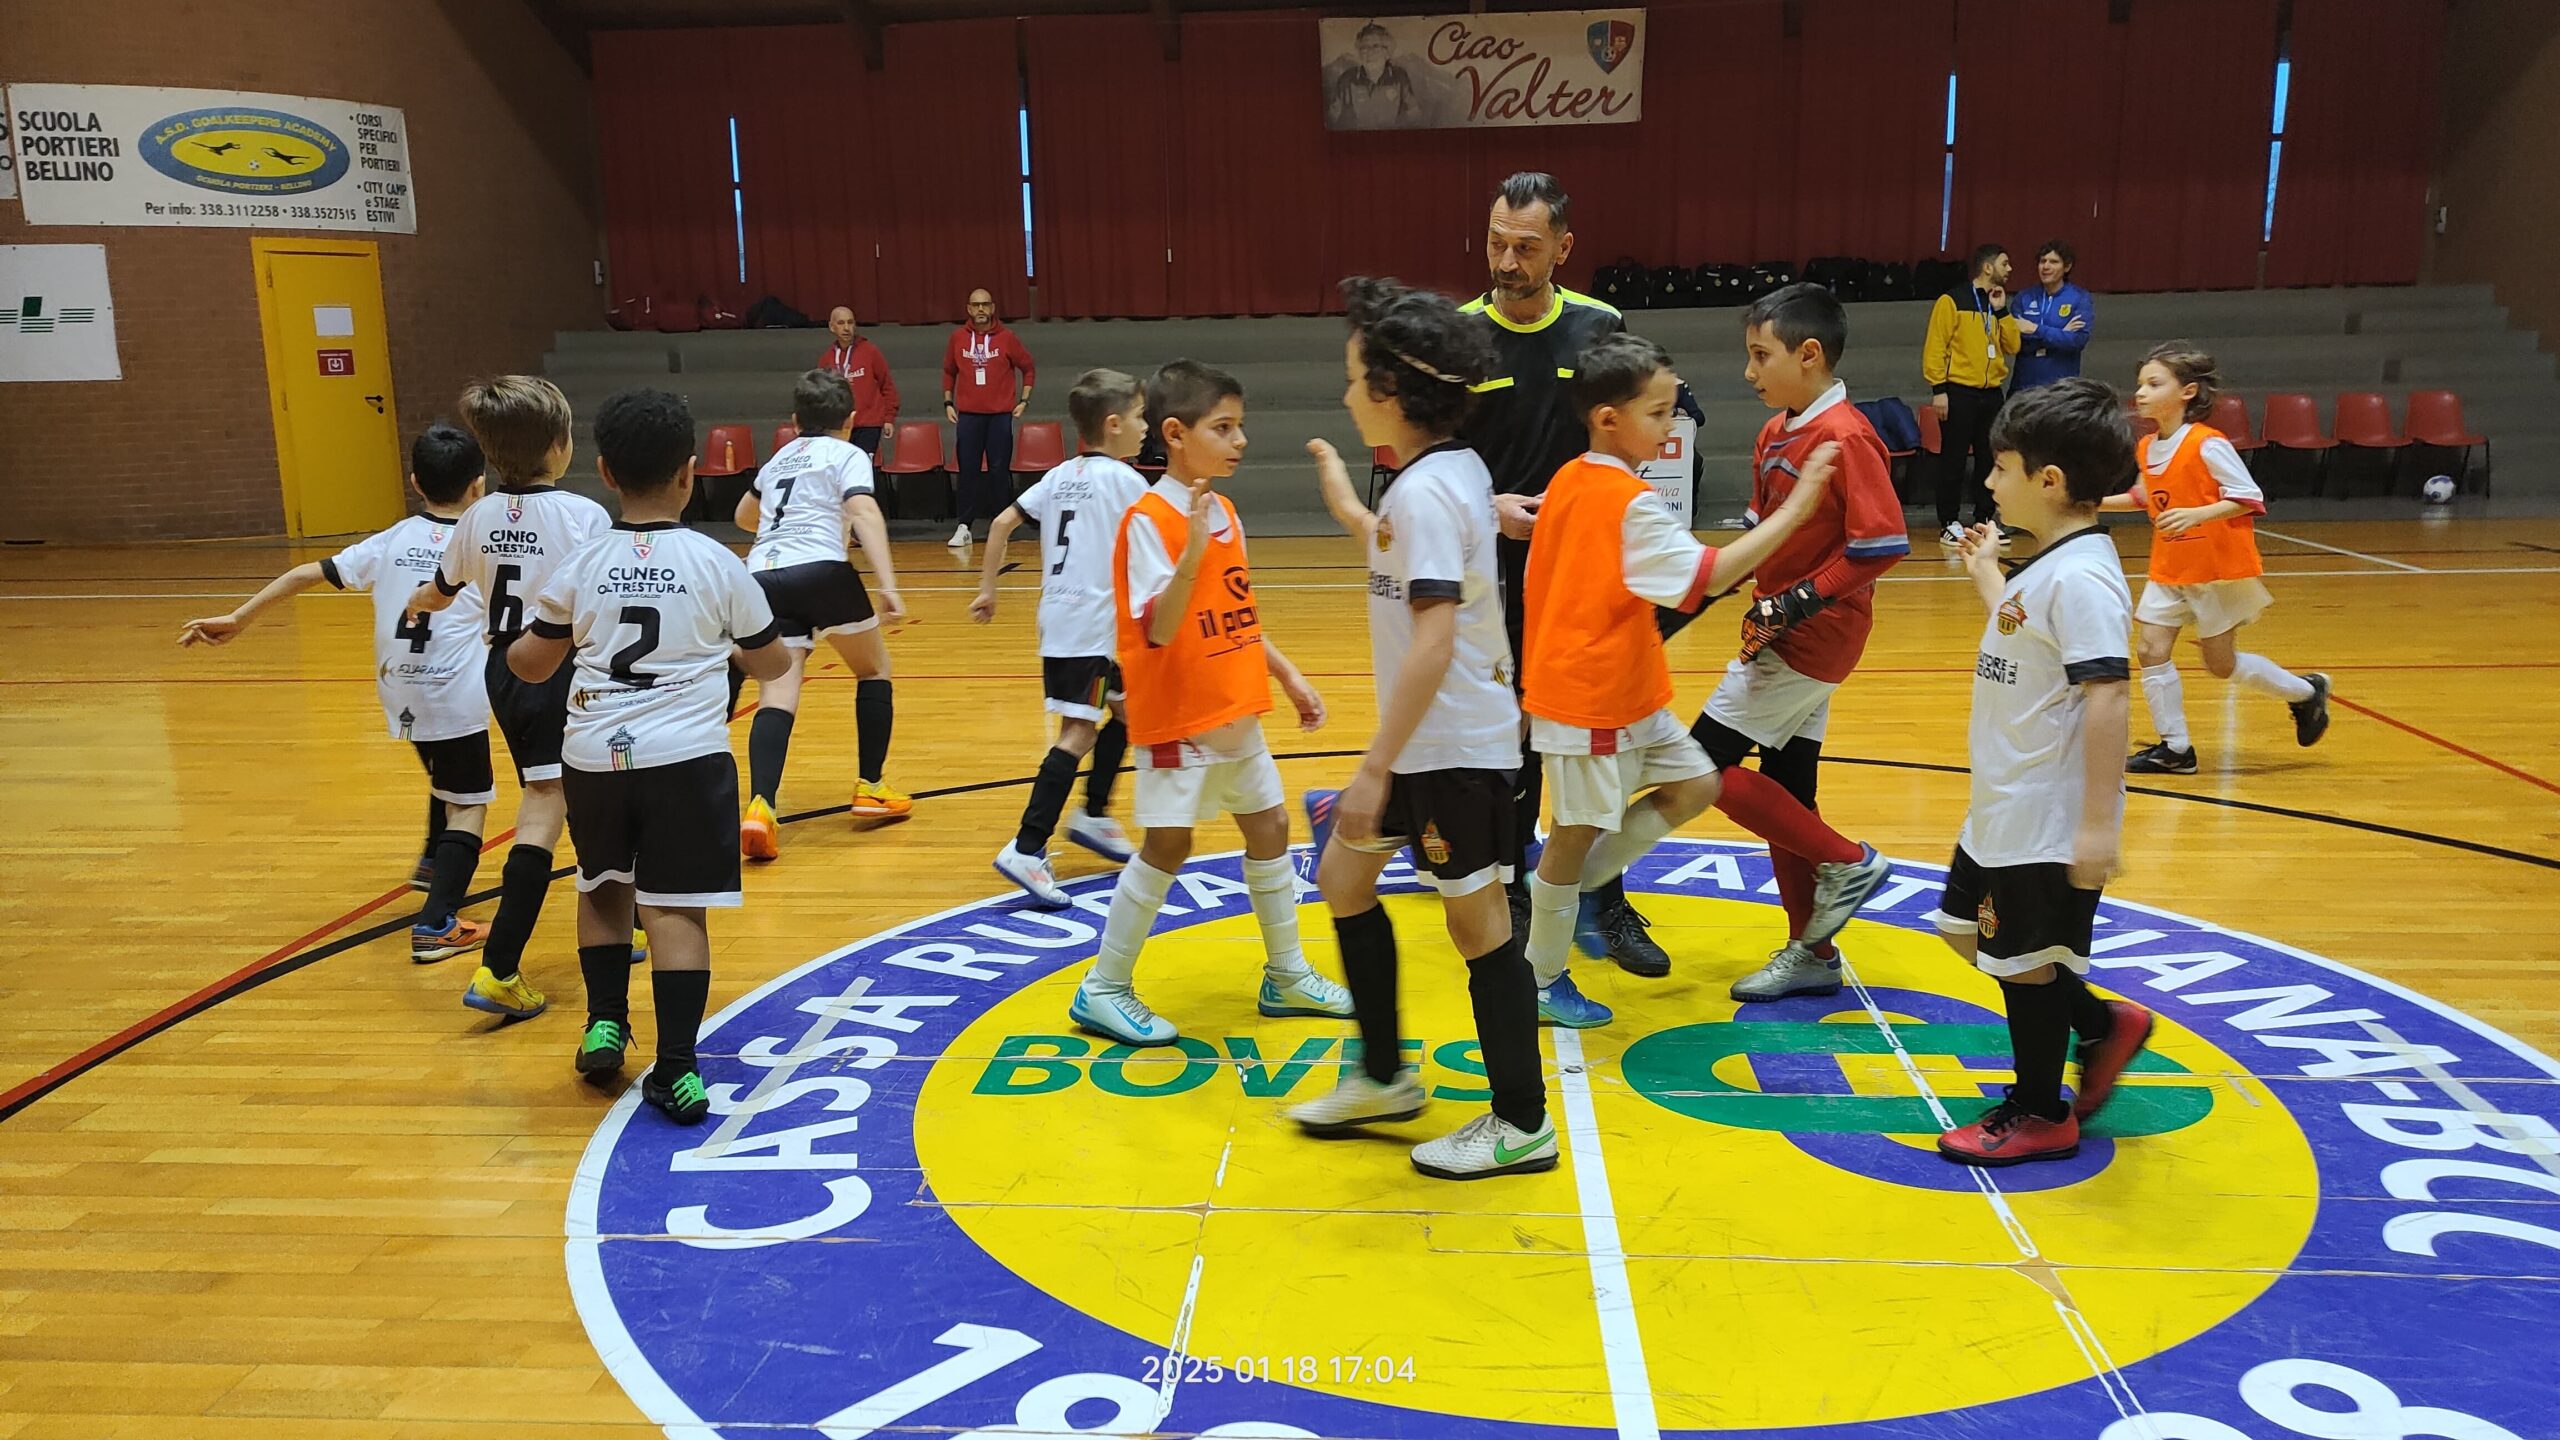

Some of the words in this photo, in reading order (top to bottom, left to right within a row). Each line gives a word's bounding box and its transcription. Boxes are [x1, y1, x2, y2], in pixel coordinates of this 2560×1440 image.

[1427, 21, 1524, 65] Ciao
[1455, 52, 1633, 122] Valter
[18, 111, 102, 132] SCUOLA
[356, 113, 382, 127] CORSI
[191, 114, 281, 129] GOALKEEPERS
[284, 121, 337, 152] ACADEMY
[357, 128, 397, 143] SPECIFICI
[21, 136, 120, 157] PORTIERI
[359, 142, 378, 155] PER
[25, 161, 114, 181] BELLINO
[360, 156, 400, 172] PORTIERI
[196, 175, 232, 188] SCUOLA
[363, 181, 383, 194] CITY
[386, 182, 407, 196] CAMP
[145, 202, 165, 215] Per
[169, 203, 196, 216] info:
[200, 203, 279, 217] 338.3112258
[291, 206, 356, 220] 338.3527515
[373, 196, 400, 209] STAGE
[366, 210, 395, 223] ESTIVI
[771, 477, 797, 531] 7
[1051, 509, 1076, 575] 5
[608, 567, 675, 581] CUNEO
[597, 582, 688, 594] OLTRESTURA
[395, 580, 433, 654] 4
[609, 606, 660, 687] 2
[666, 995, 960, 1249] CASSA
